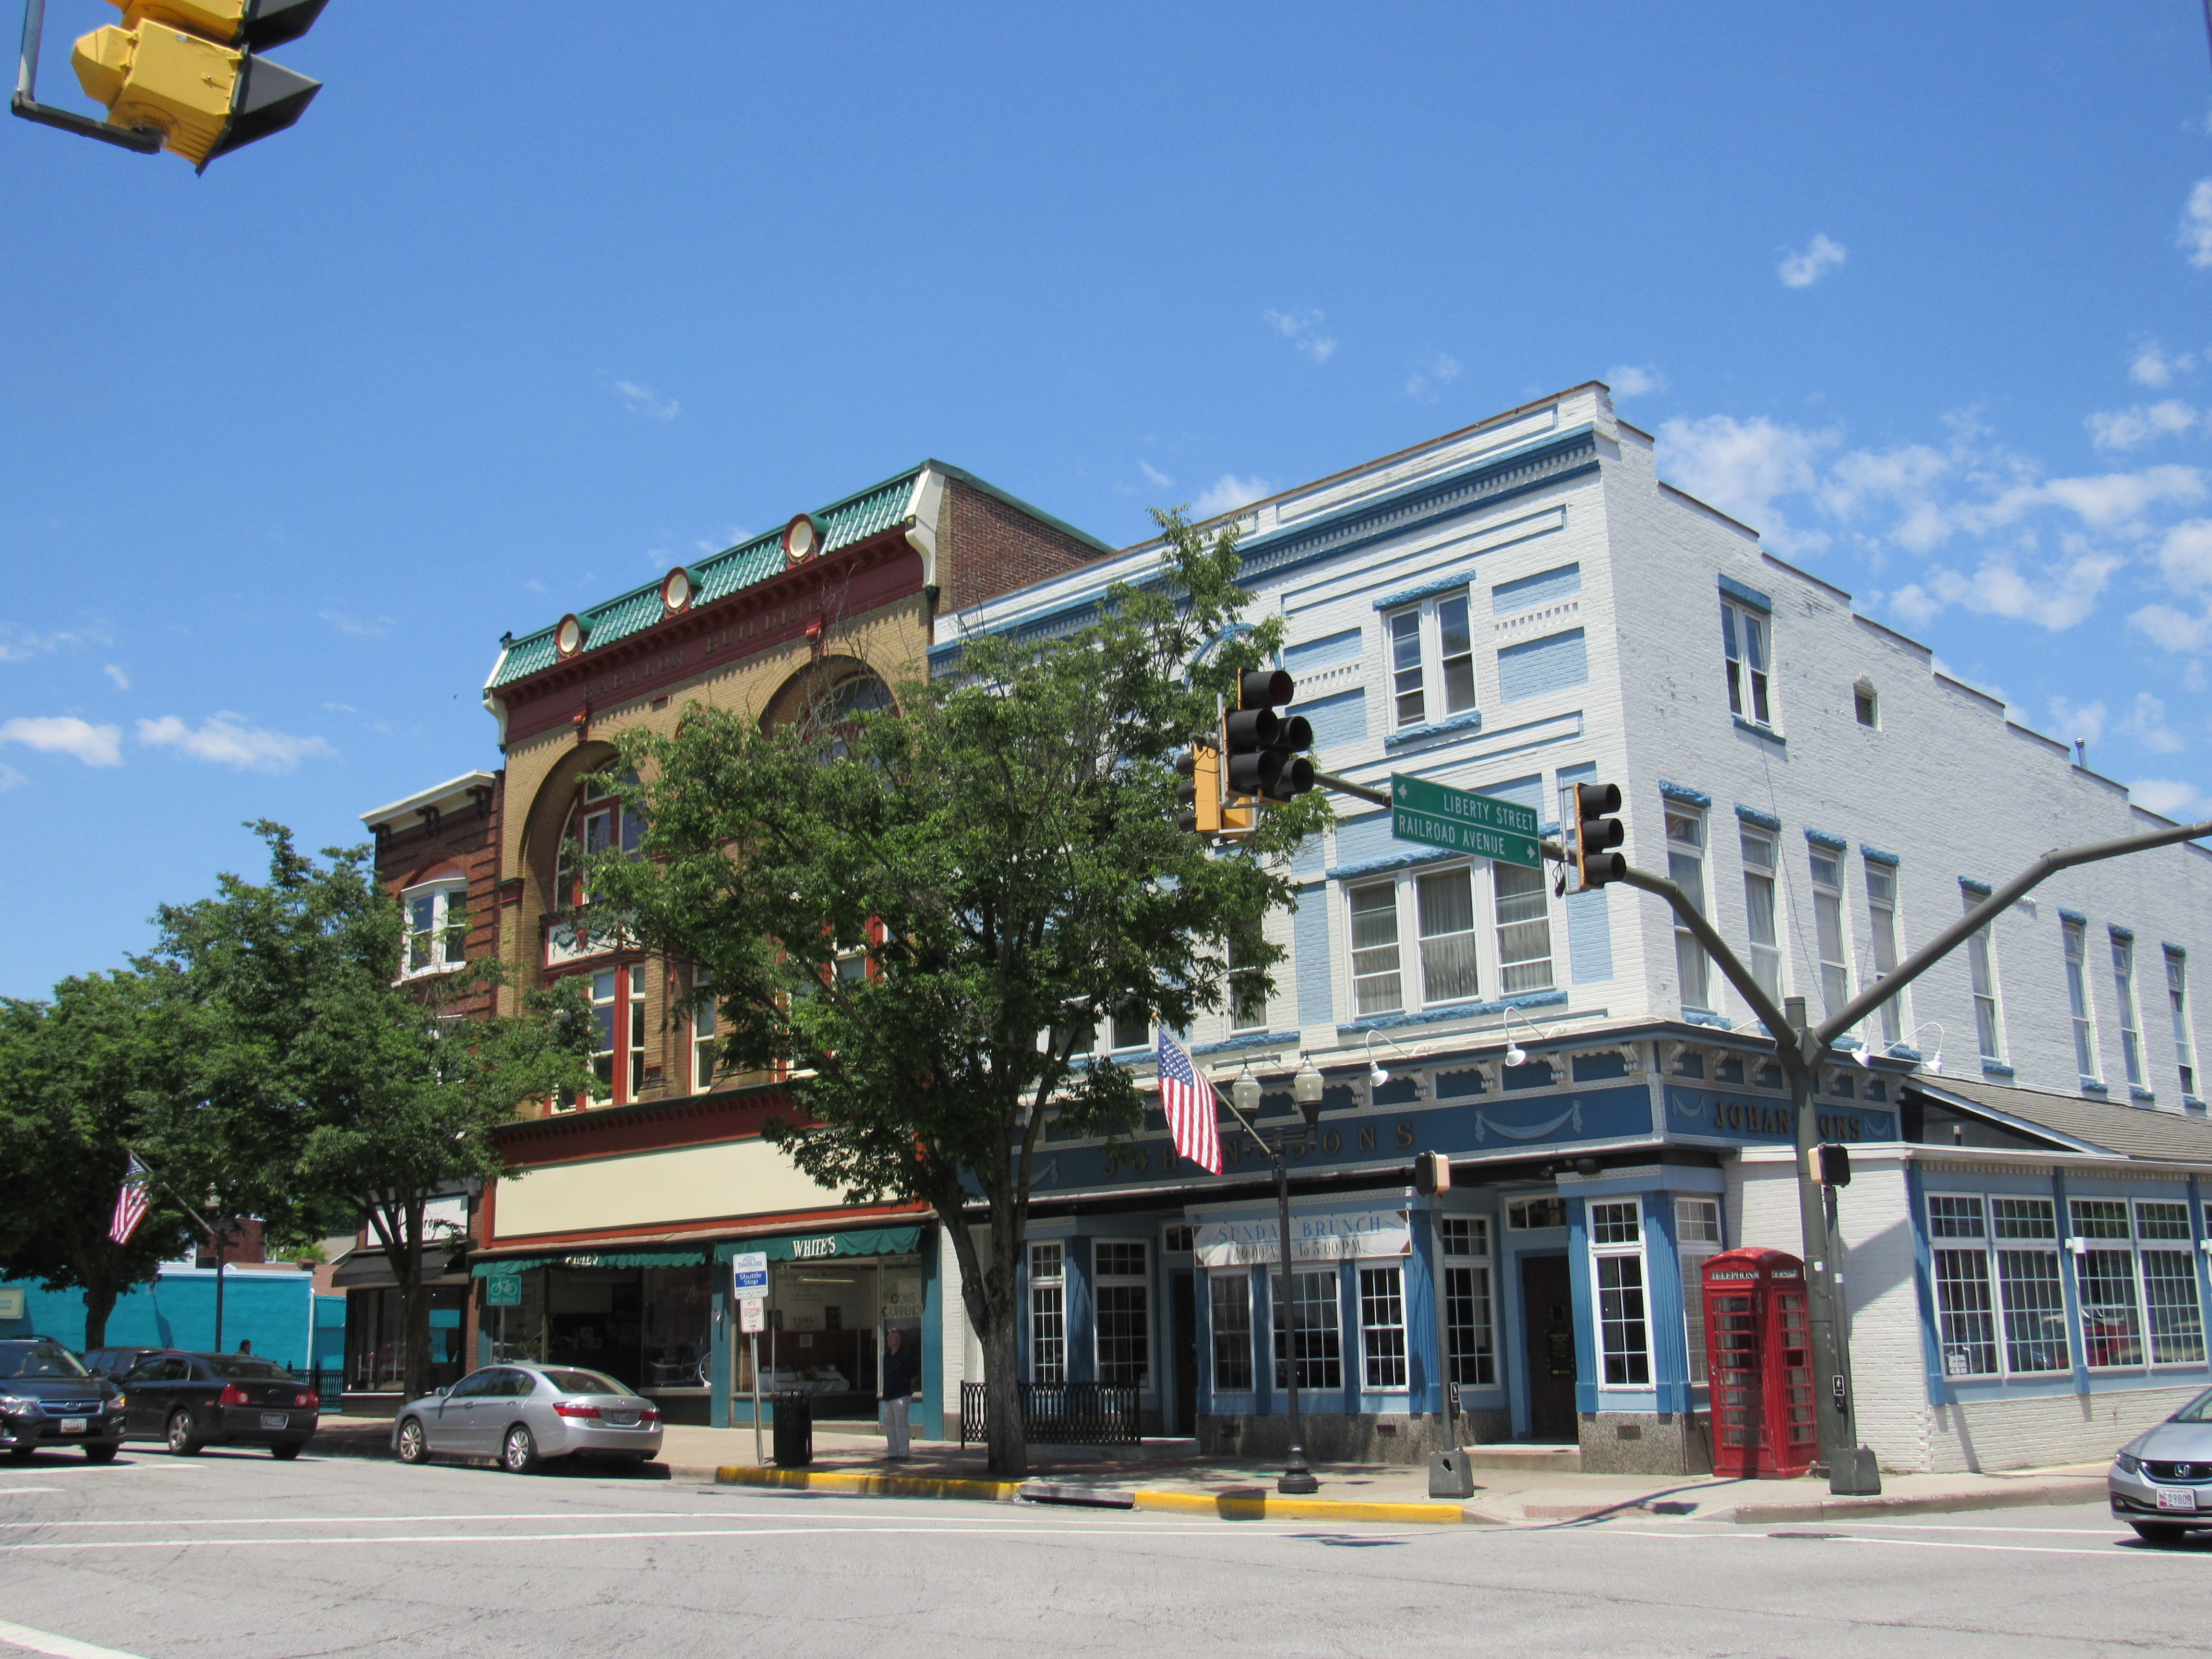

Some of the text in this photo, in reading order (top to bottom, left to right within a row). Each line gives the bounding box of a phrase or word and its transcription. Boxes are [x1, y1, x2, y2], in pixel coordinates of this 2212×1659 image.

[582, 598, 821, 701] BABYLON BUILDING
[1444, 793, 1533, 831] LIBERTY STREET
[1399, 815, 1505, 855] RAILROAD AVENUE
[1716, 1102, 1861, 1141] JOHANONS
[1219, 1216, 1381, 1242] SUNDA BRUNCH
[792, 1236, 836, 1257] WHITE'S
[1298, 1243, 1310, 1257] To
[891, 1293, 915, 1304] COINS
